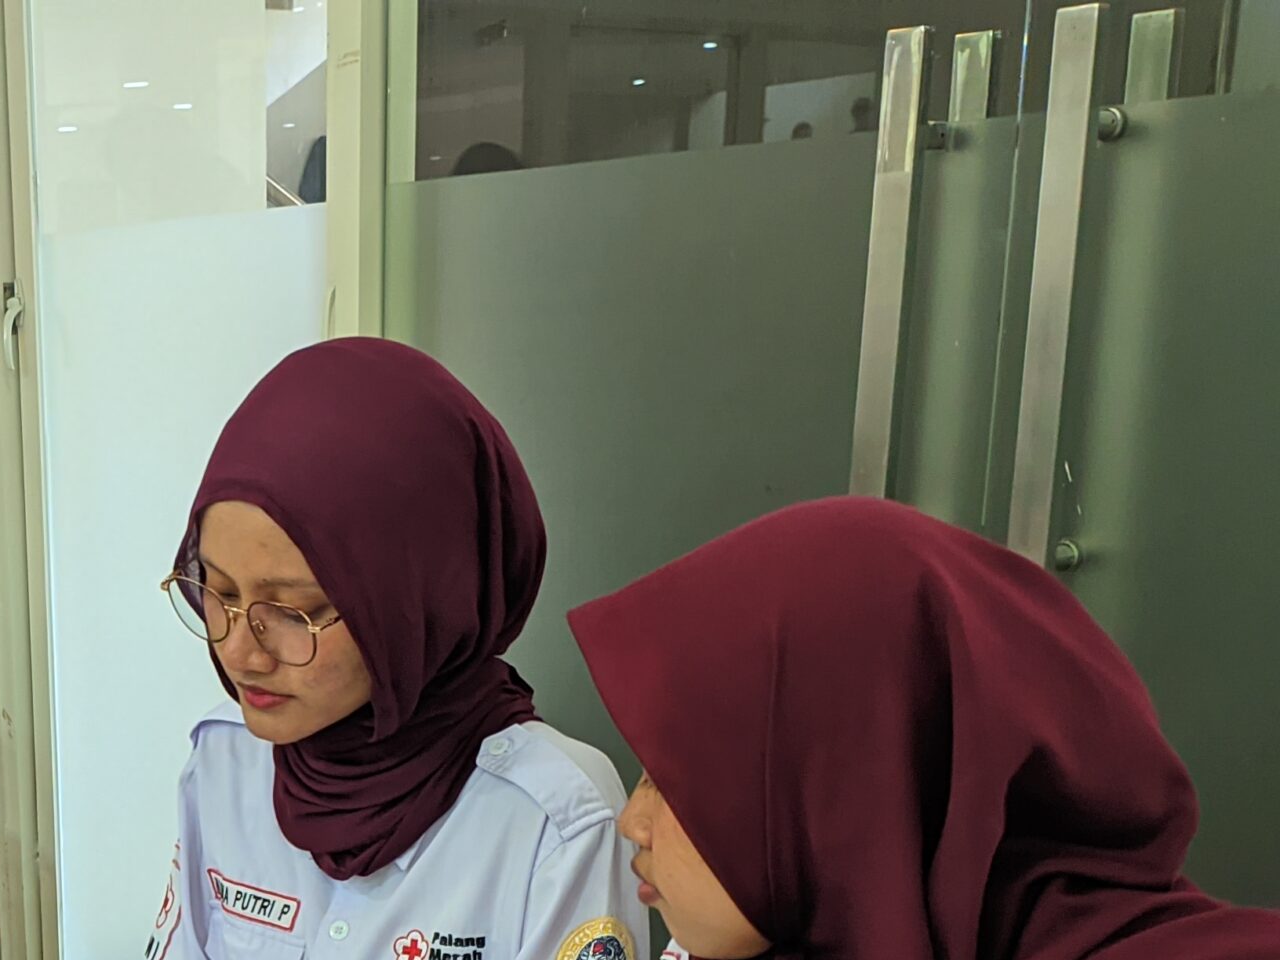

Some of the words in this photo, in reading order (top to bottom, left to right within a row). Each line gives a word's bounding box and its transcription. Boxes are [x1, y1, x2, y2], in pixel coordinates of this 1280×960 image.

[233, 890, 276, 918] PUTRI
[278, 904, 291, 921] P
[432, 932, 486, 948] Palang
